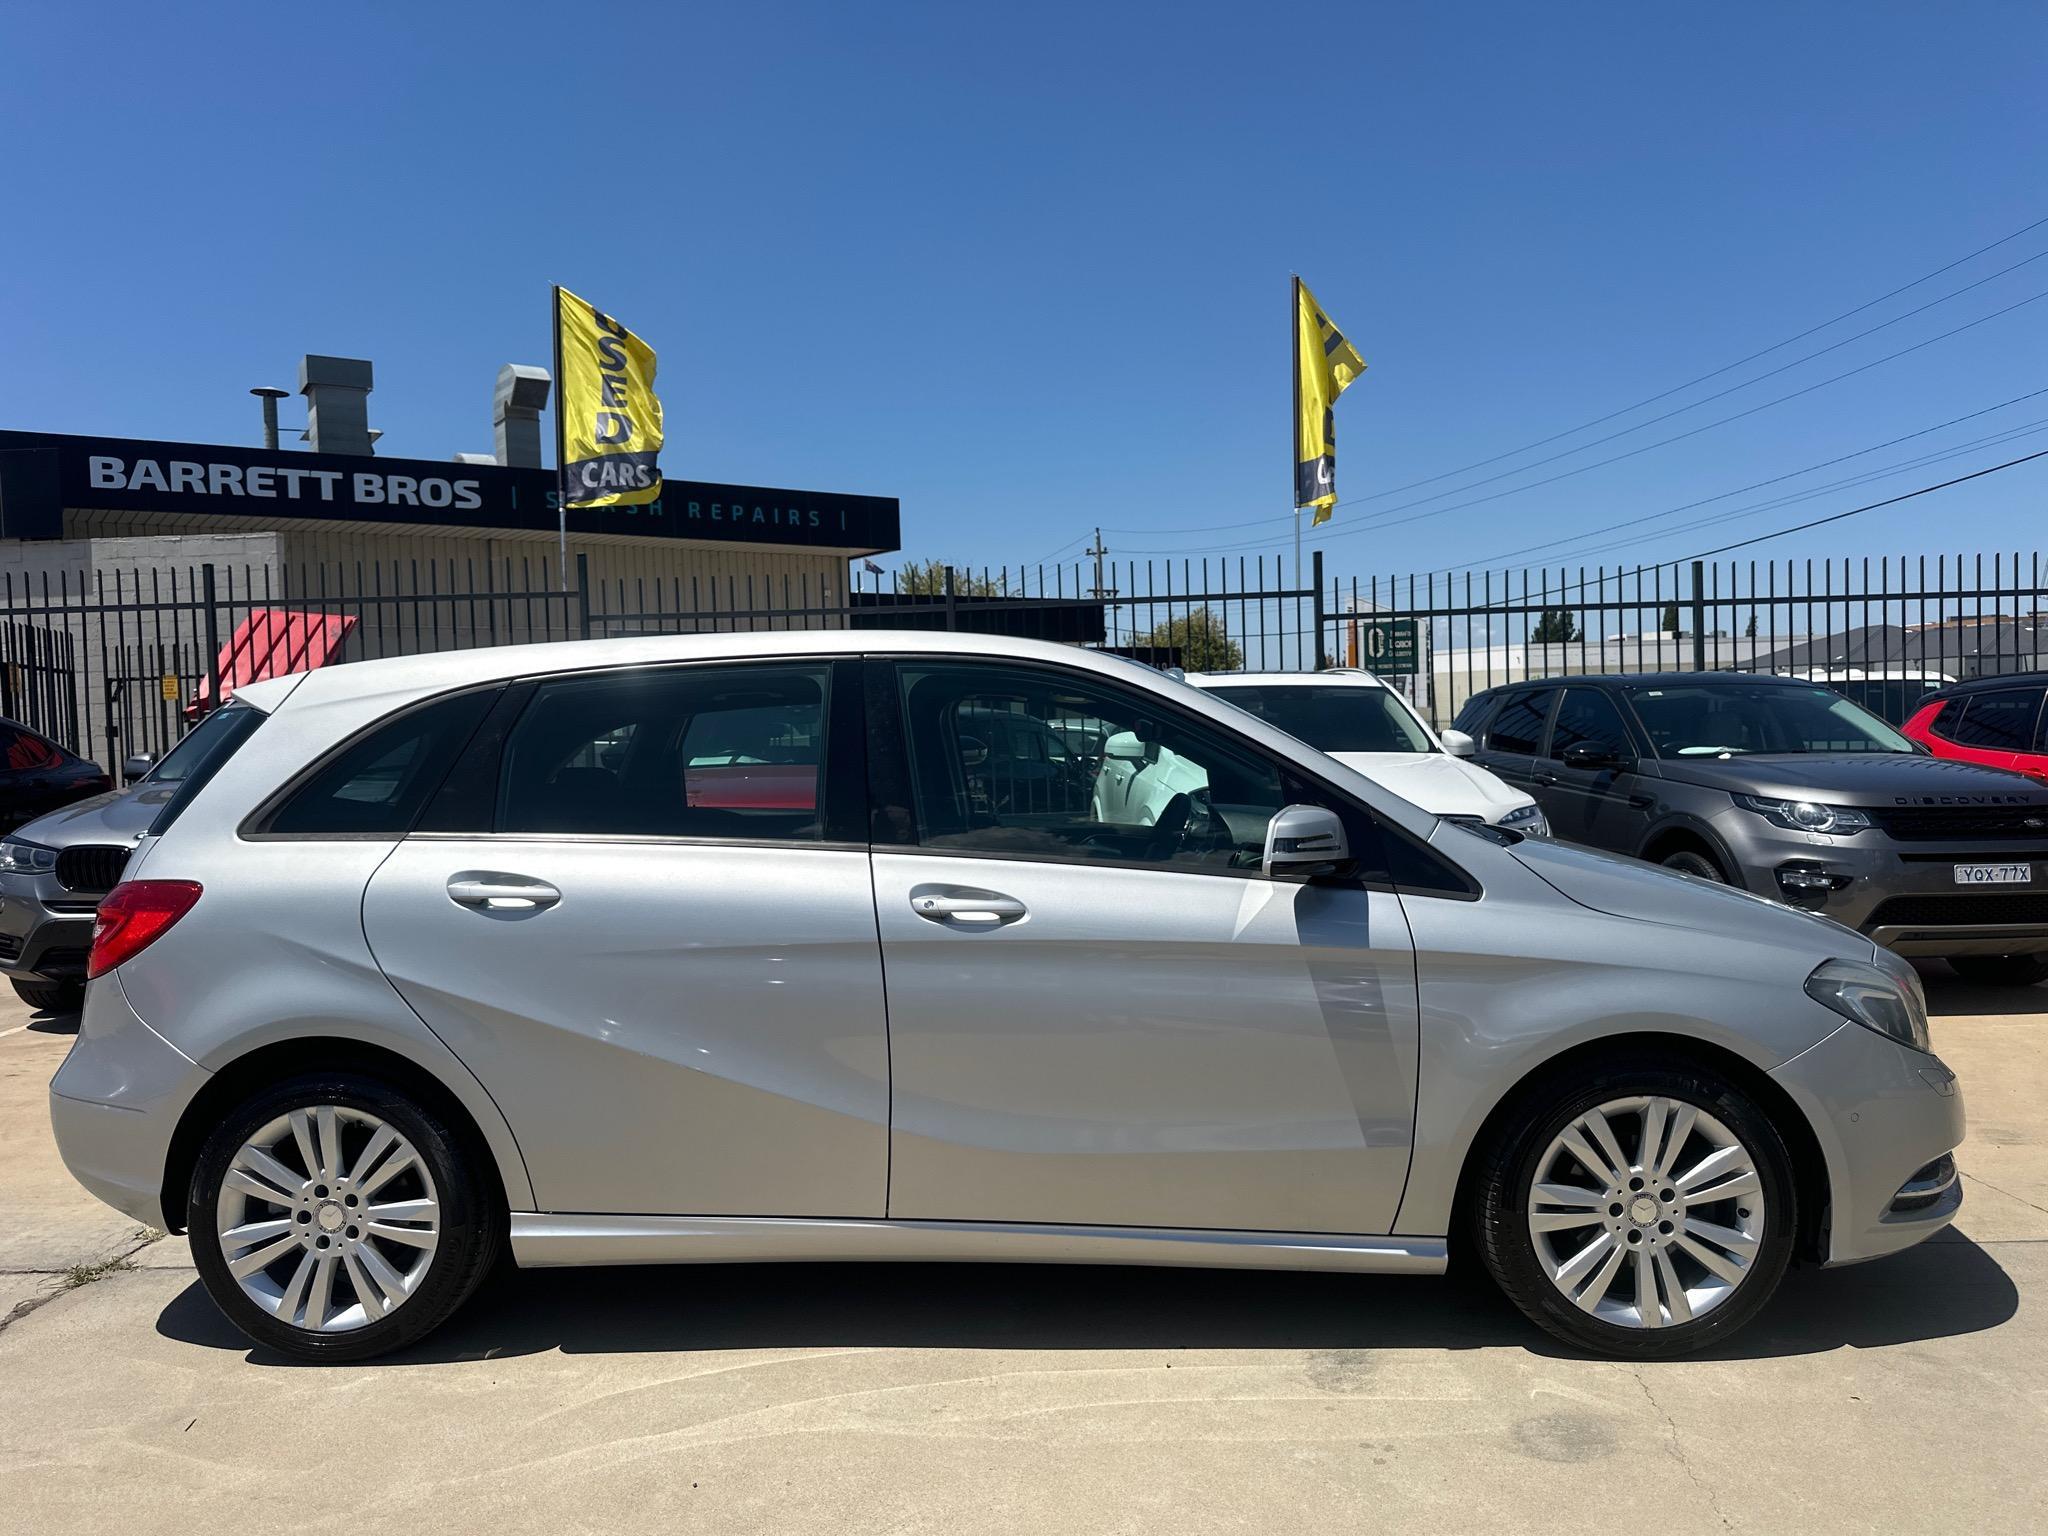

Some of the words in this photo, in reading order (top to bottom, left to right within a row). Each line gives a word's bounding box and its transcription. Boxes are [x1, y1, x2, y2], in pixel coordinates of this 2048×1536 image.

[89, 455, 343, 501] BARRETT
[352, 472, 483, 510] BROS
[581, 461, 652, 488] CARS
[689, 501, 820, 527] REPAIRS
[1894, 796, 2030, 805] DISCOVERY
